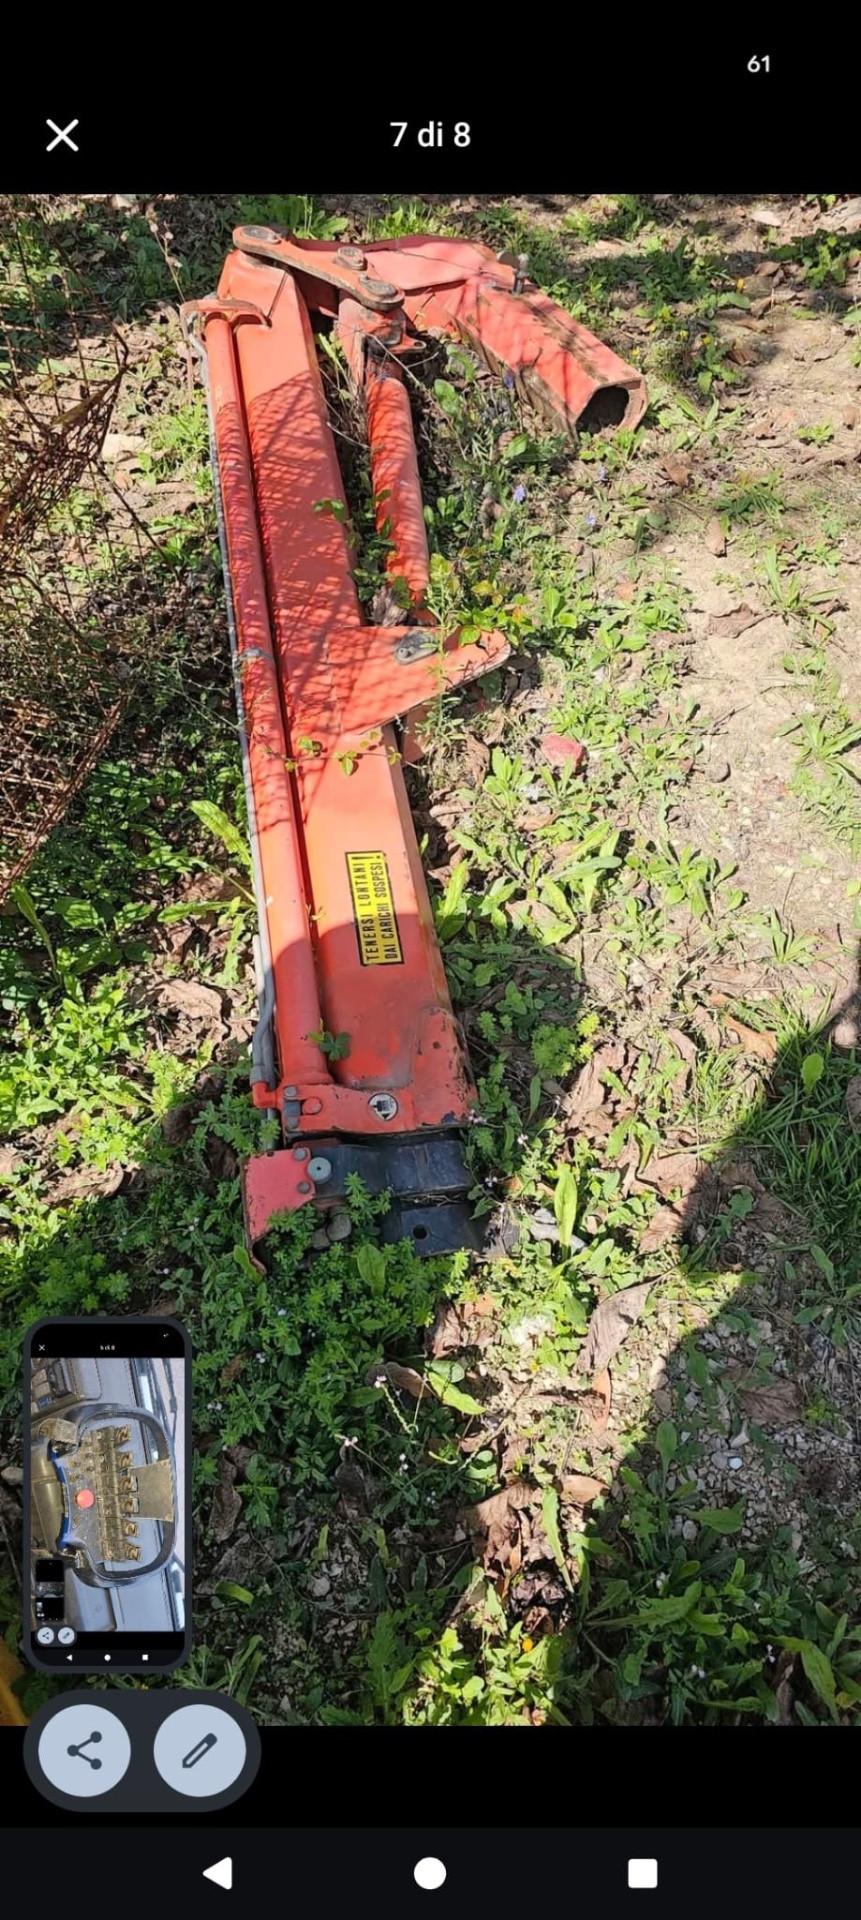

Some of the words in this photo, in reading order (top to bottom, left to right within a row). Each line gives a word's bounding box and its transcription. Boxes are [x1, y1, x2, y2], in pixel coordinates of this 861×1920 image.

[353, 863, 372, 906] LONTANI
[370, 862, 388, 898] SOSPESI
[360, 914, 380, 960] TENERSI
[376, 903, 395, 939] CARICHI
[383, 944, 398, 959] DAI
